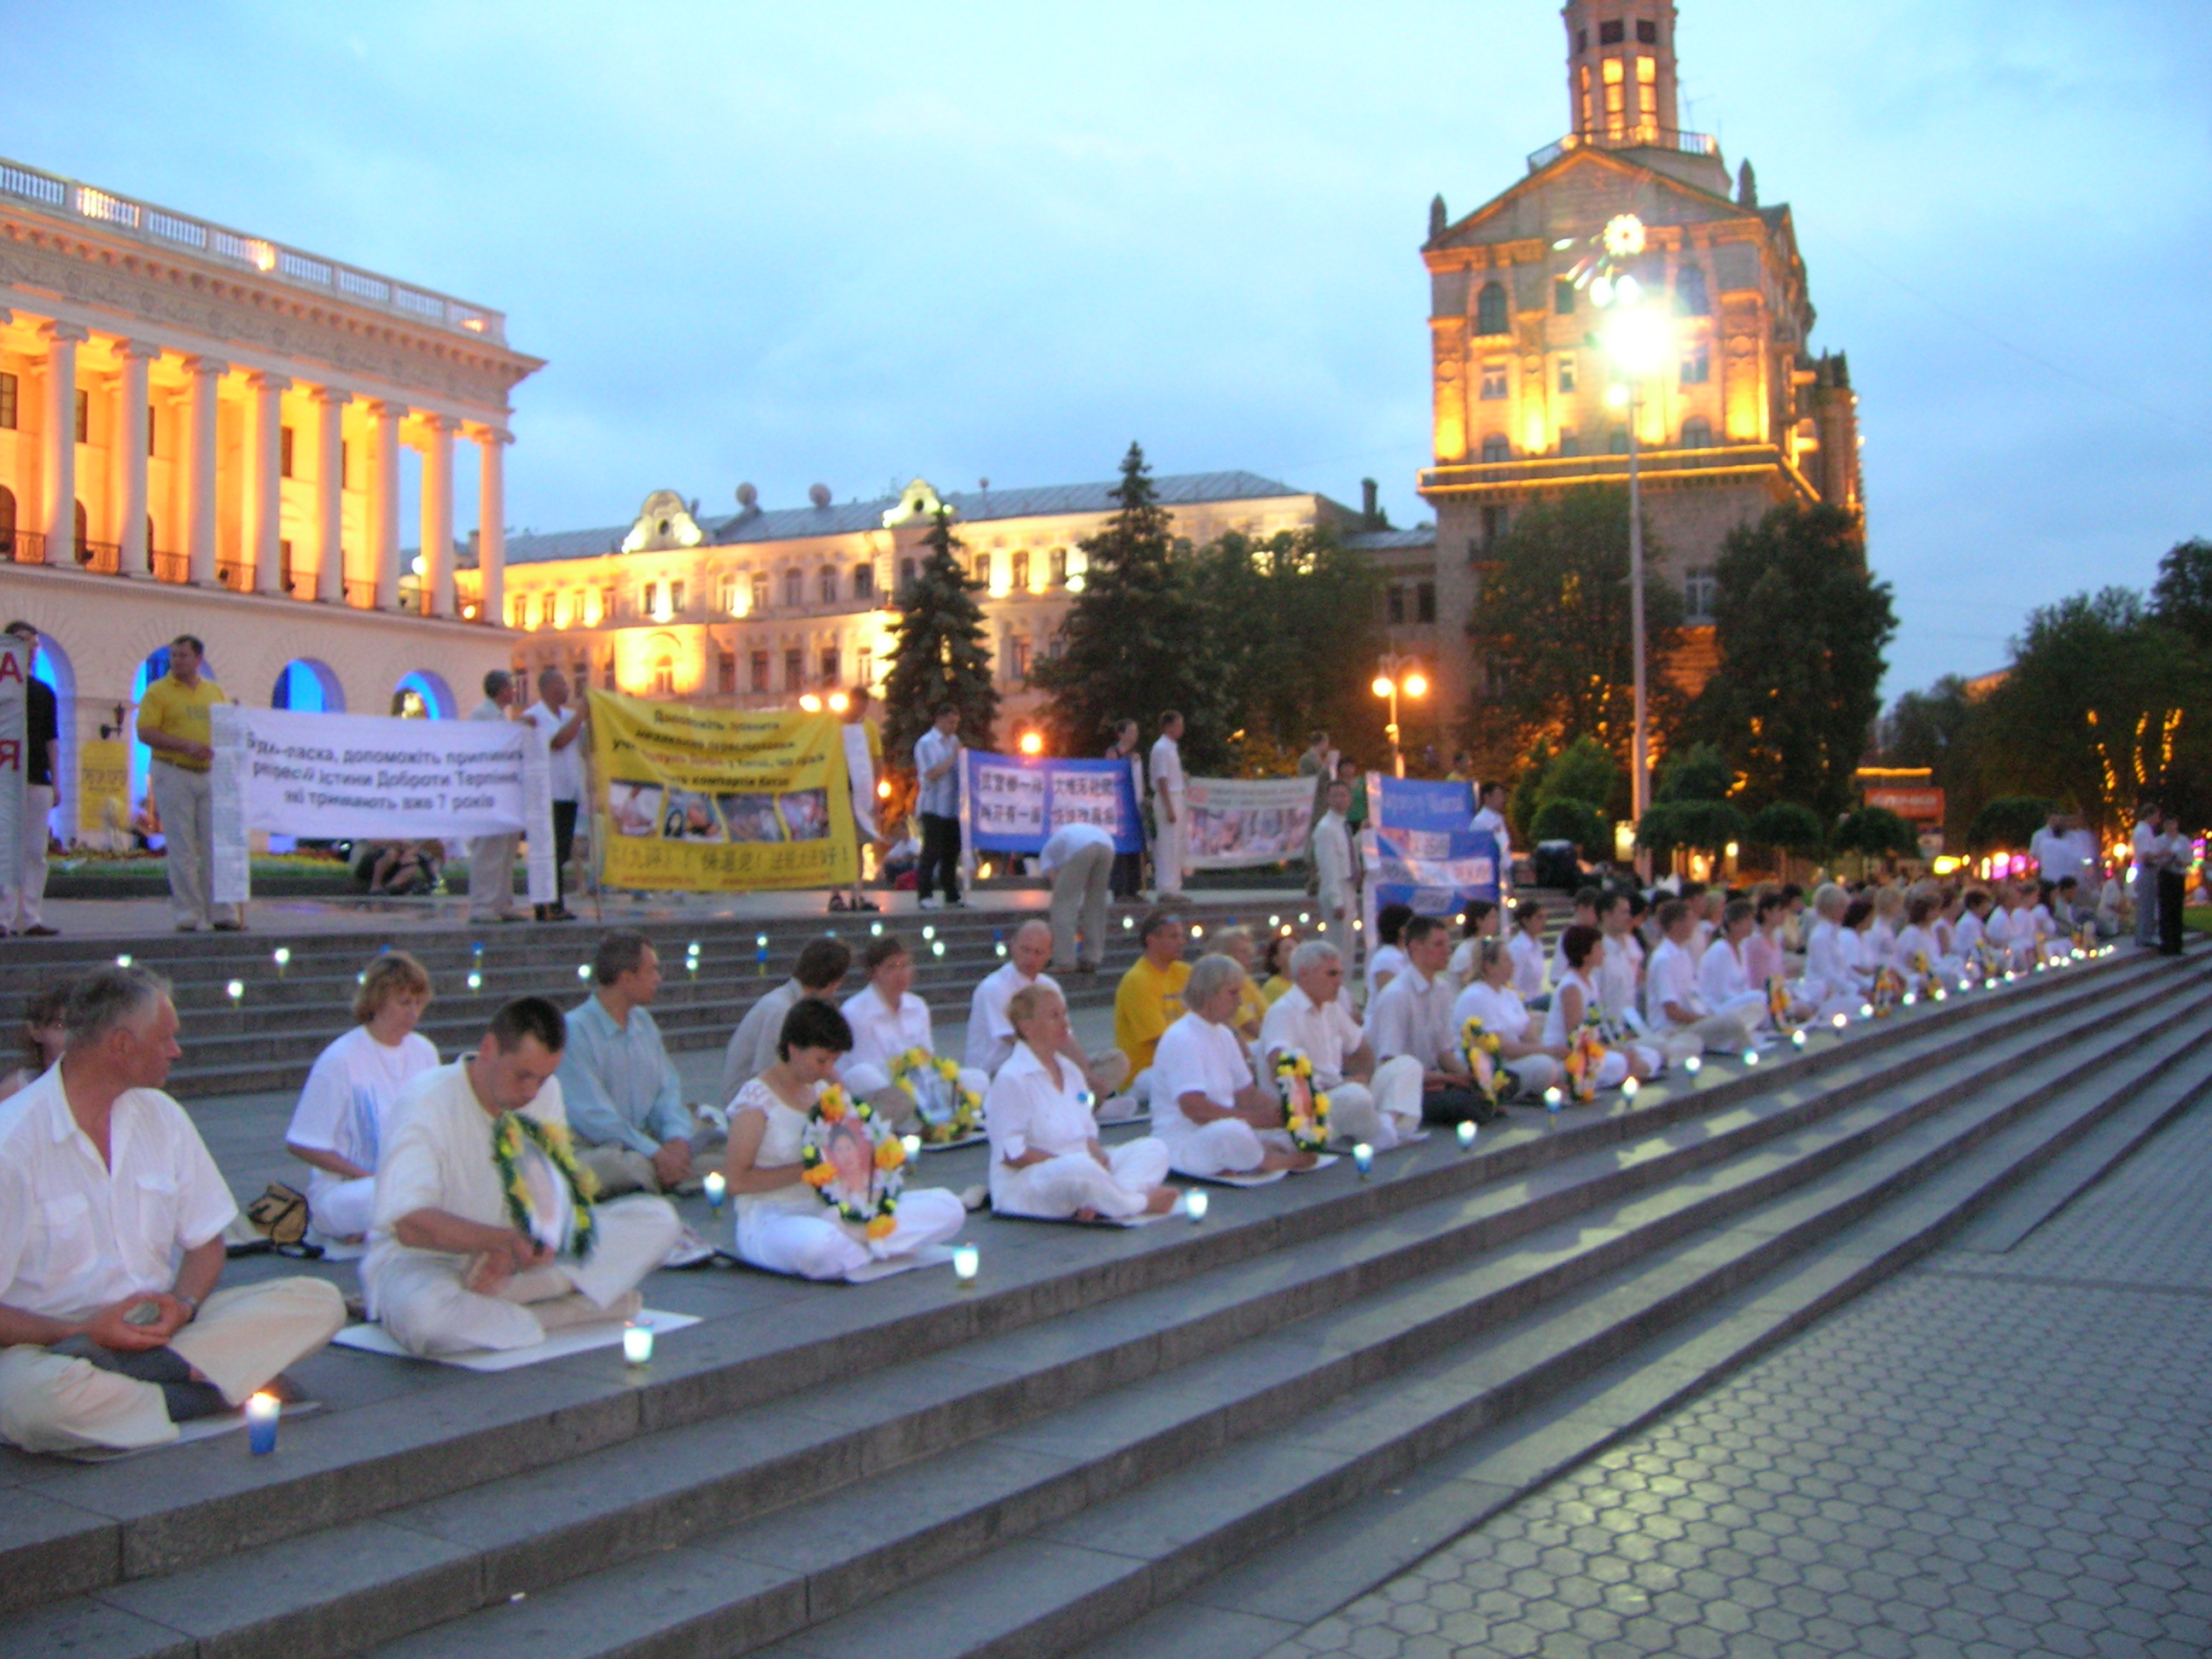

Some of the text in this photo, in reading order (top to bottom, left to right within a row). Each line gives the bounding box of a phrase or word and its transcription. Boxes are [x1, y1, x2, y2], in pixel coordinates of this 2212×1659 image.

[342, 748, 441, 765] допоможіть
[402, 795, 434, 811] вже
[437, 792, 445, 810] 7
